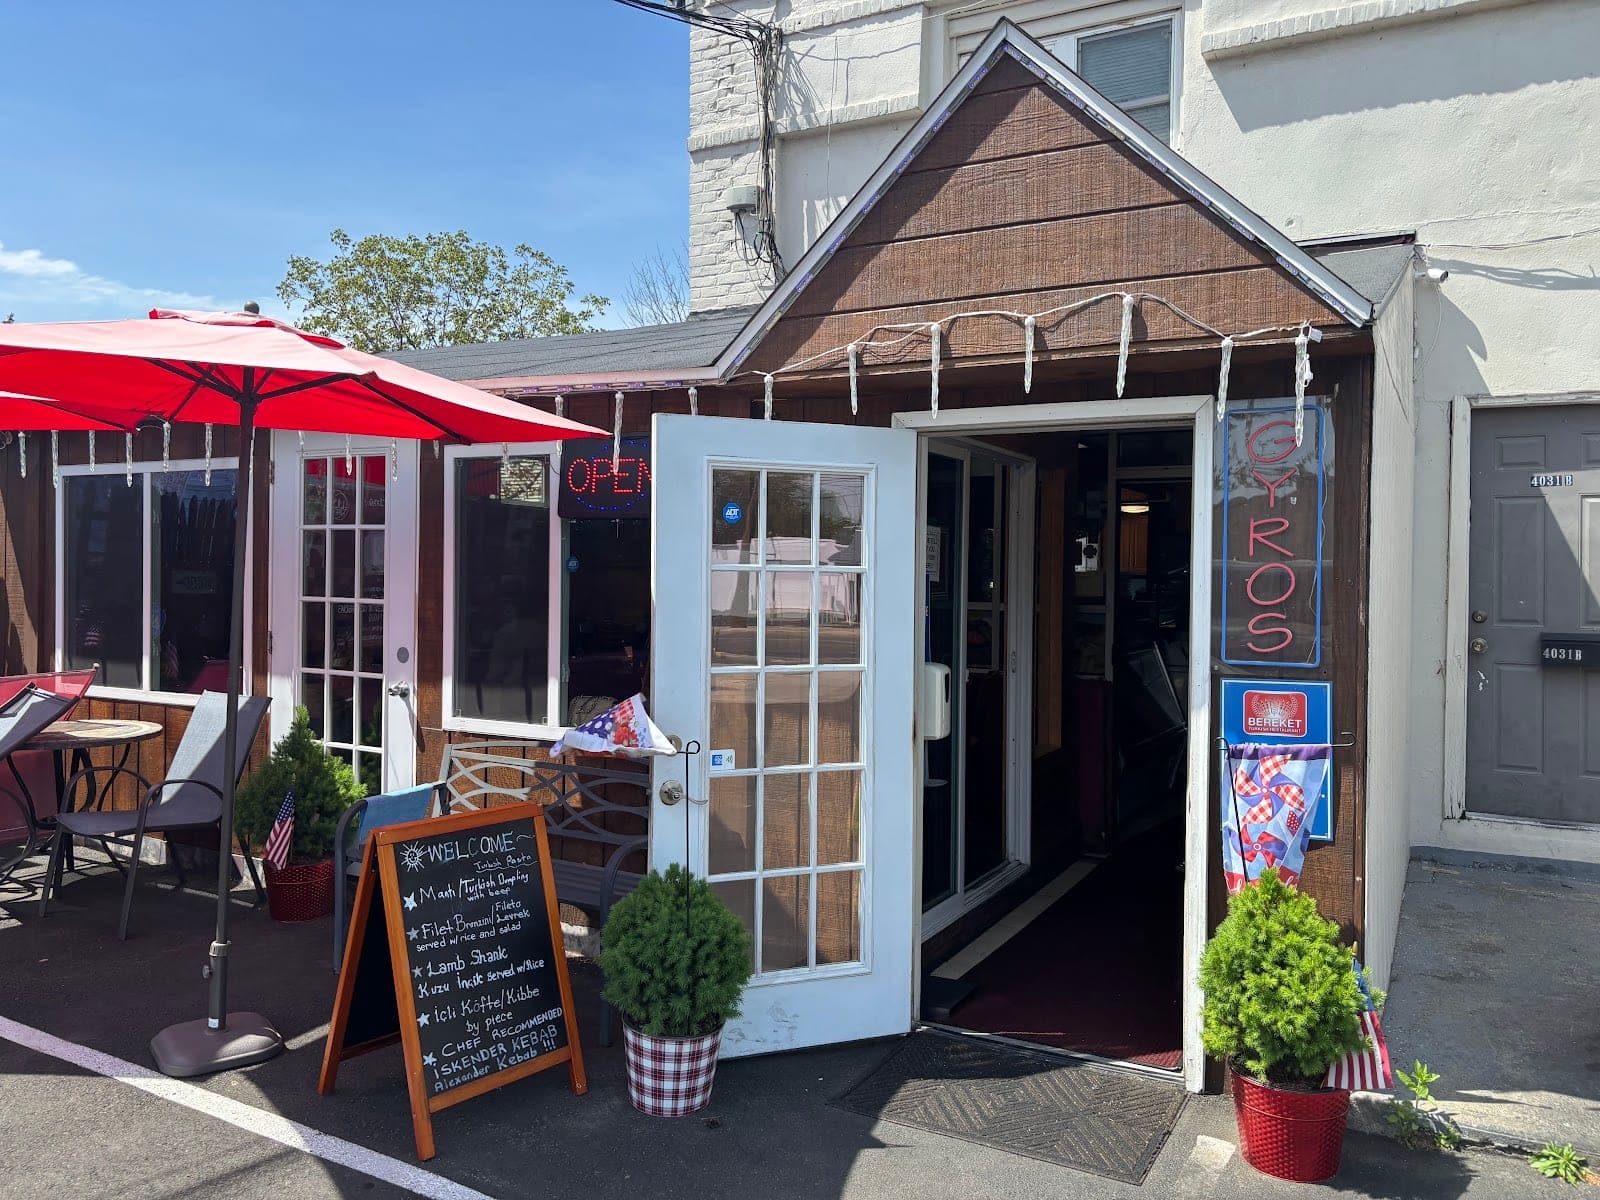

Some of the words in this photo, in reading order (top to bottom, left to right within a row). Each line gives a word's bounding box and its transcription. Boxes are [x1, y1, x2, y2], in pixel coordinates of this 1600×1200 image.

[567, 457, 652, 493] OPEN
[1531, 475, 1572, 487] 4031B
[1247, 419, 1298, 653] GYROS
[1542, 648, 1582, 661] 4031B
[1248, 717, 1302, 729] BEREKET
[428, 831, 517, 863] WELCOME
[416, 937, 447, 952] served
[479, 926, 496, 939] and
[499, 921, 521, 935] salad
[426, 954, 466, 978] Lamb
[470, 945, 508, 966] Shank
[418, 982, 450, 999] Kuzu
[487, 963, 515, 982] served
[441, 1037, 481, 1057] CHEF
[491, 1007, 563, 1041] RECOMMENDED
[466, 1020, 480, 1036] by
[485, 1011, 514, 1032] piece
[511, 1024, 558, 1054] KEBAB
[434, 1065, 490, 1092] Alexander
[496, 1047, 538, 1071] Kebab
